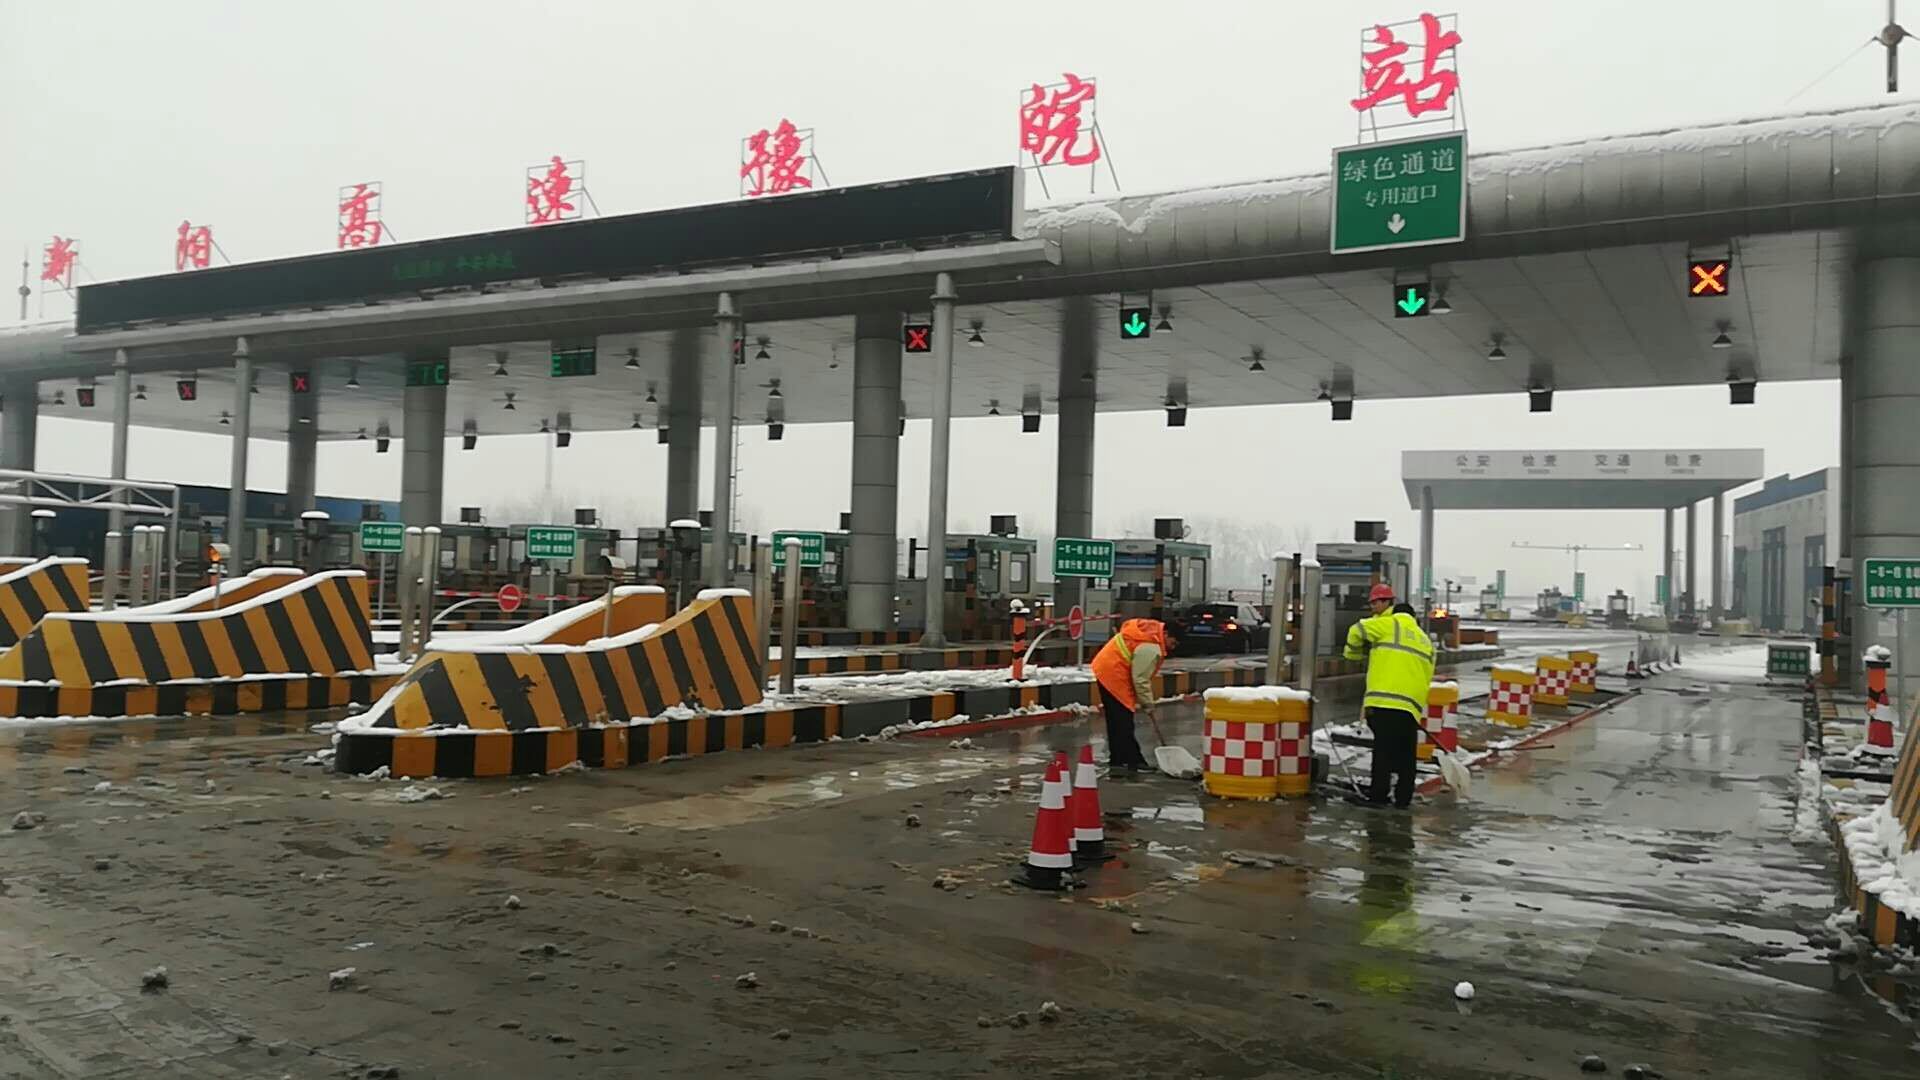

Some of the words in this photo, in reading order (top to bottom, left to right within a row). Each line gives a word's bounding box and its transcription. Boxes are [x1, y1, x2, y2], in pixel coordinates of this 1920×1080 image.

[1343, 147, 1456, 182] 绿色通道
[1364, 184, 1437, 207] 专用道口
